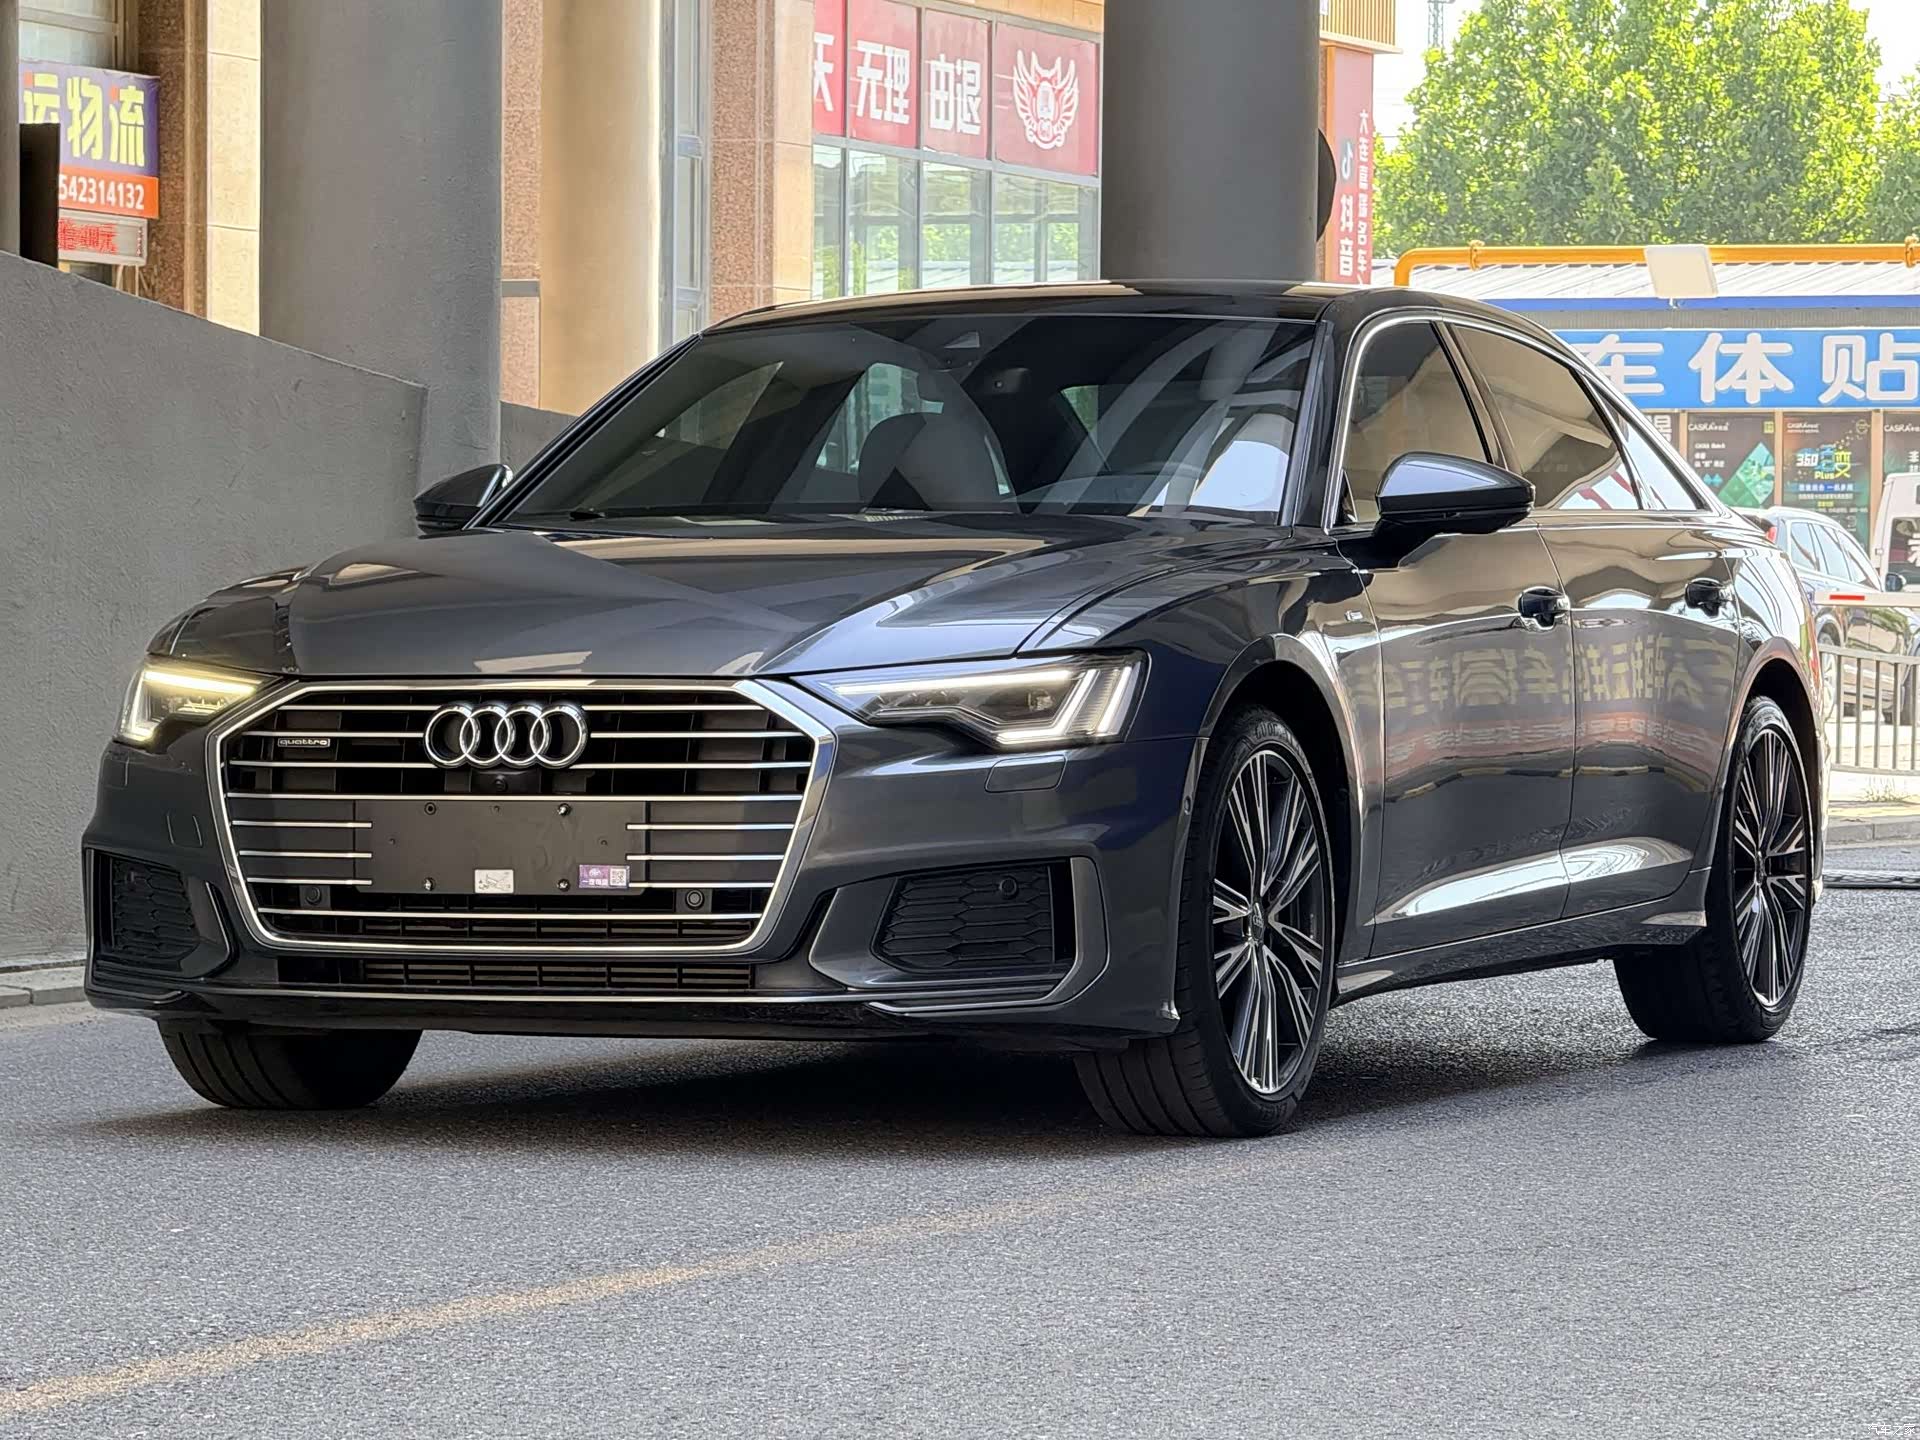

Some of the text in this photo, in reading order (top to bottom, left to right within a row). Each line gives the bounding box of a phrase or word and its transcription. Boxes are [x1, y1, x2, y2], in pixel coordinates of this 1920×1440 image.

[23, 73, 145, 167] 运物流
[59, 174, 144, 210] 542314132
[1340, 194, 1354, 276] 抖音
[1575, 332, 1920, 404] 车体贴
[280, 739, 327, 747] quattro
